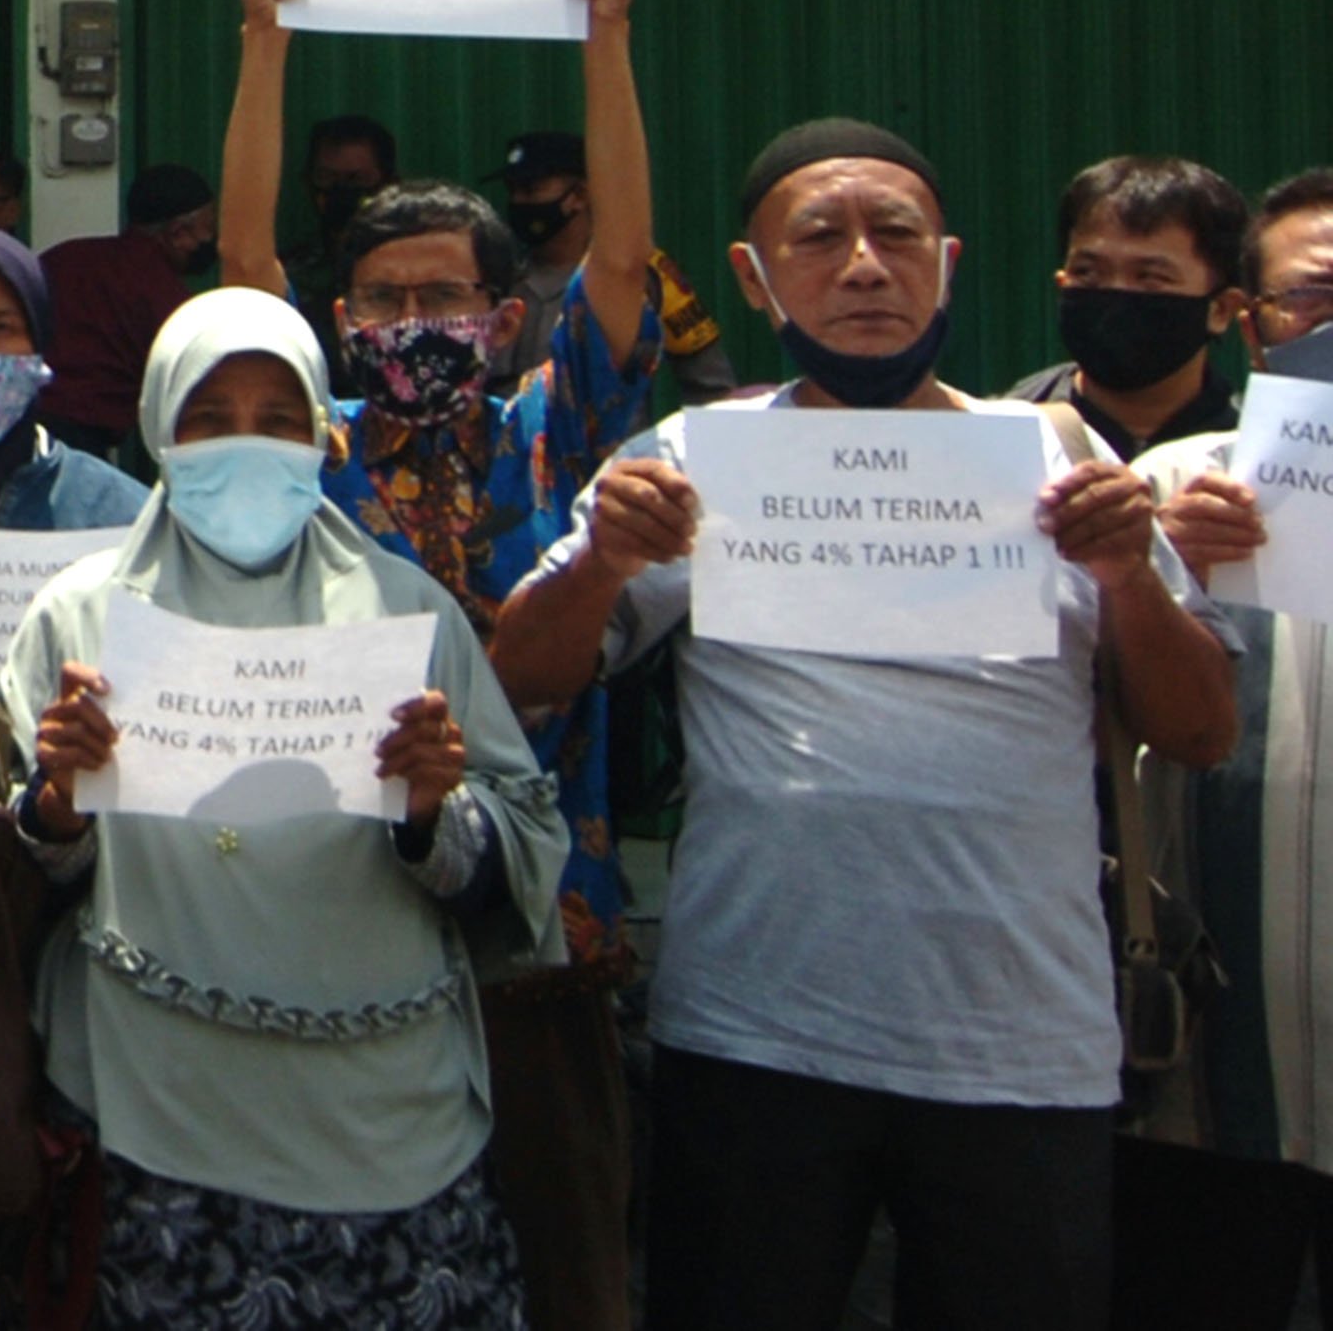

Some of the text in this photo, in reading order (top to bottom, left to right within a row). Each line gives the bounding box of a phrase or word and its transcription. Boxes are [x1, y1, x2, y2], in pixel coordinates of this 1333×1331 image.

[1279, 419, 1333, 446] KAM
[832, 447, 910, 472] KAMI
[761, 496, 985, 523] BELUM TERIMA
[722, 539, 1027, 570] YANG 4% TAHAP 1 !!!
[233, 659, 307, 680] KAMI
[157, 691, 365, 720] BELUM TERIMA
[114, 717, 190, 750] YANG
[197, 735, 237, 757] 4%
[246, 734, 337, 756] TAHAP
[343, 731, 355, 750] 1
